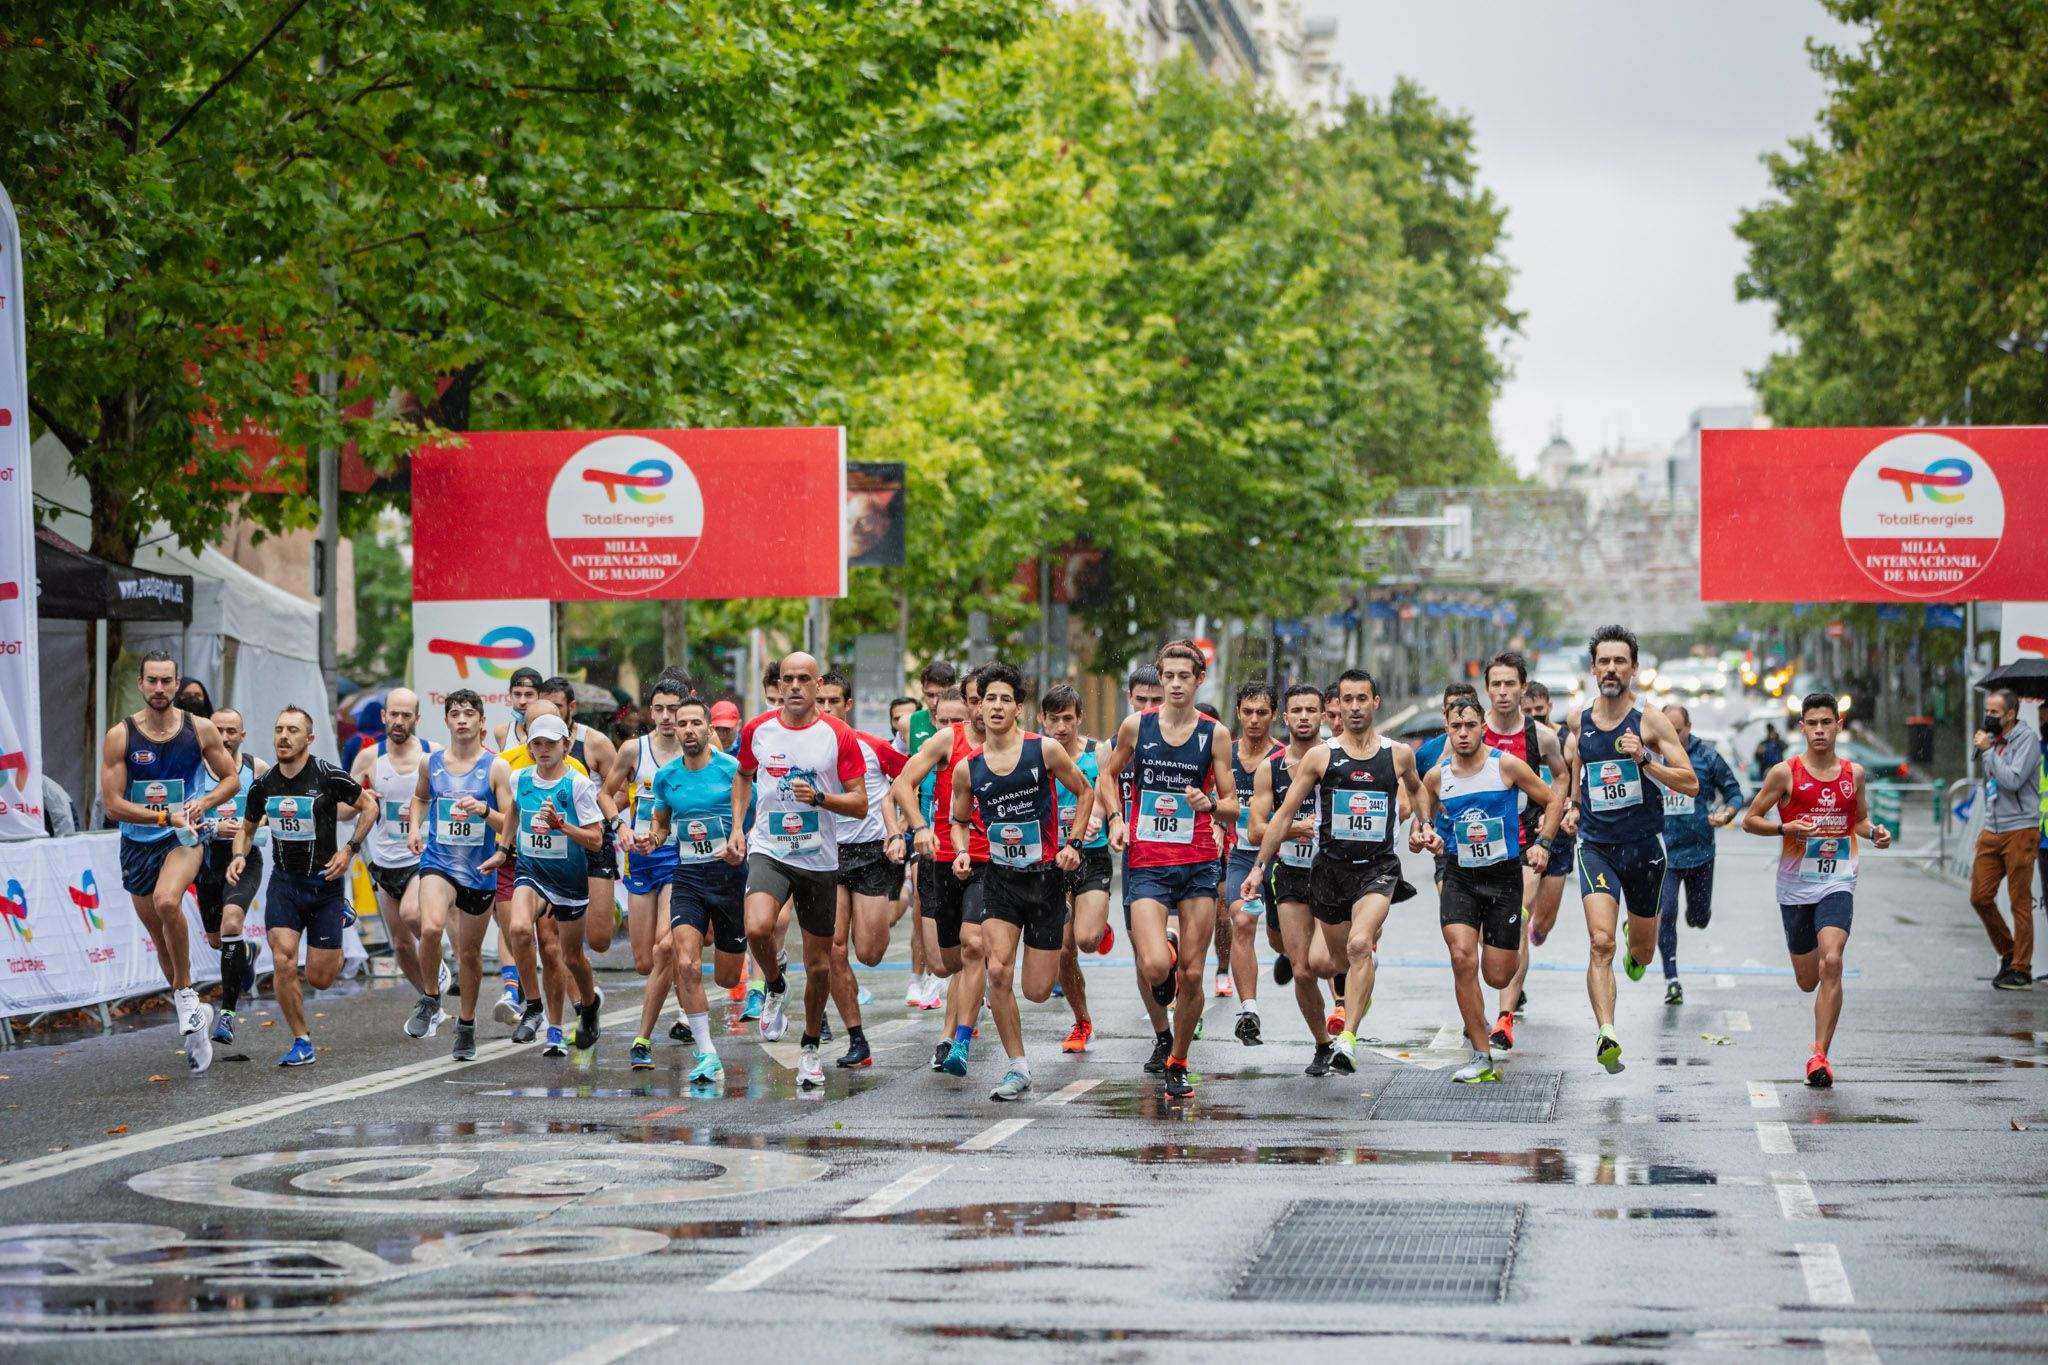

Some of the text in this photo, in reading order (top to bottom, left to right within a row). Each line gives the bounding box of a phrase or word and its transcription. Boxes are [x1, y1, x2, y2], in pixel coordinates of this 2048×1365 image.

[582, 514, 675, 528] TotalEnergies
[1877, 514, 1974, 528] TotalEnergies
[605, 541, 648, 553] MILLA
[1901, 541, 1946, 553] MILLA
[588, 568, 665, 580] DE MADRID
[1884, 569, 1964, 581] DE MADRID
[1156, 771, 1193, 787] alquiber
[1602, 783, 1627, 799] 136
[1006, 801, 1034, 814] alquiber
[279, 818, 300, 832] 153
[448, 822, 471, 837] 138
[1153, 816, 1178, 832] 103
[1347, 816, 1372, 831] 145
[530, 834, 552, 850] 143
[691, 840, 714, 855] 148
[790, 841, 800, 850] 36
[1002, 845, 1027, 858] 104
[1469, 842, 1491, 858] 151
[1817, 859, 1838, 873] 137
